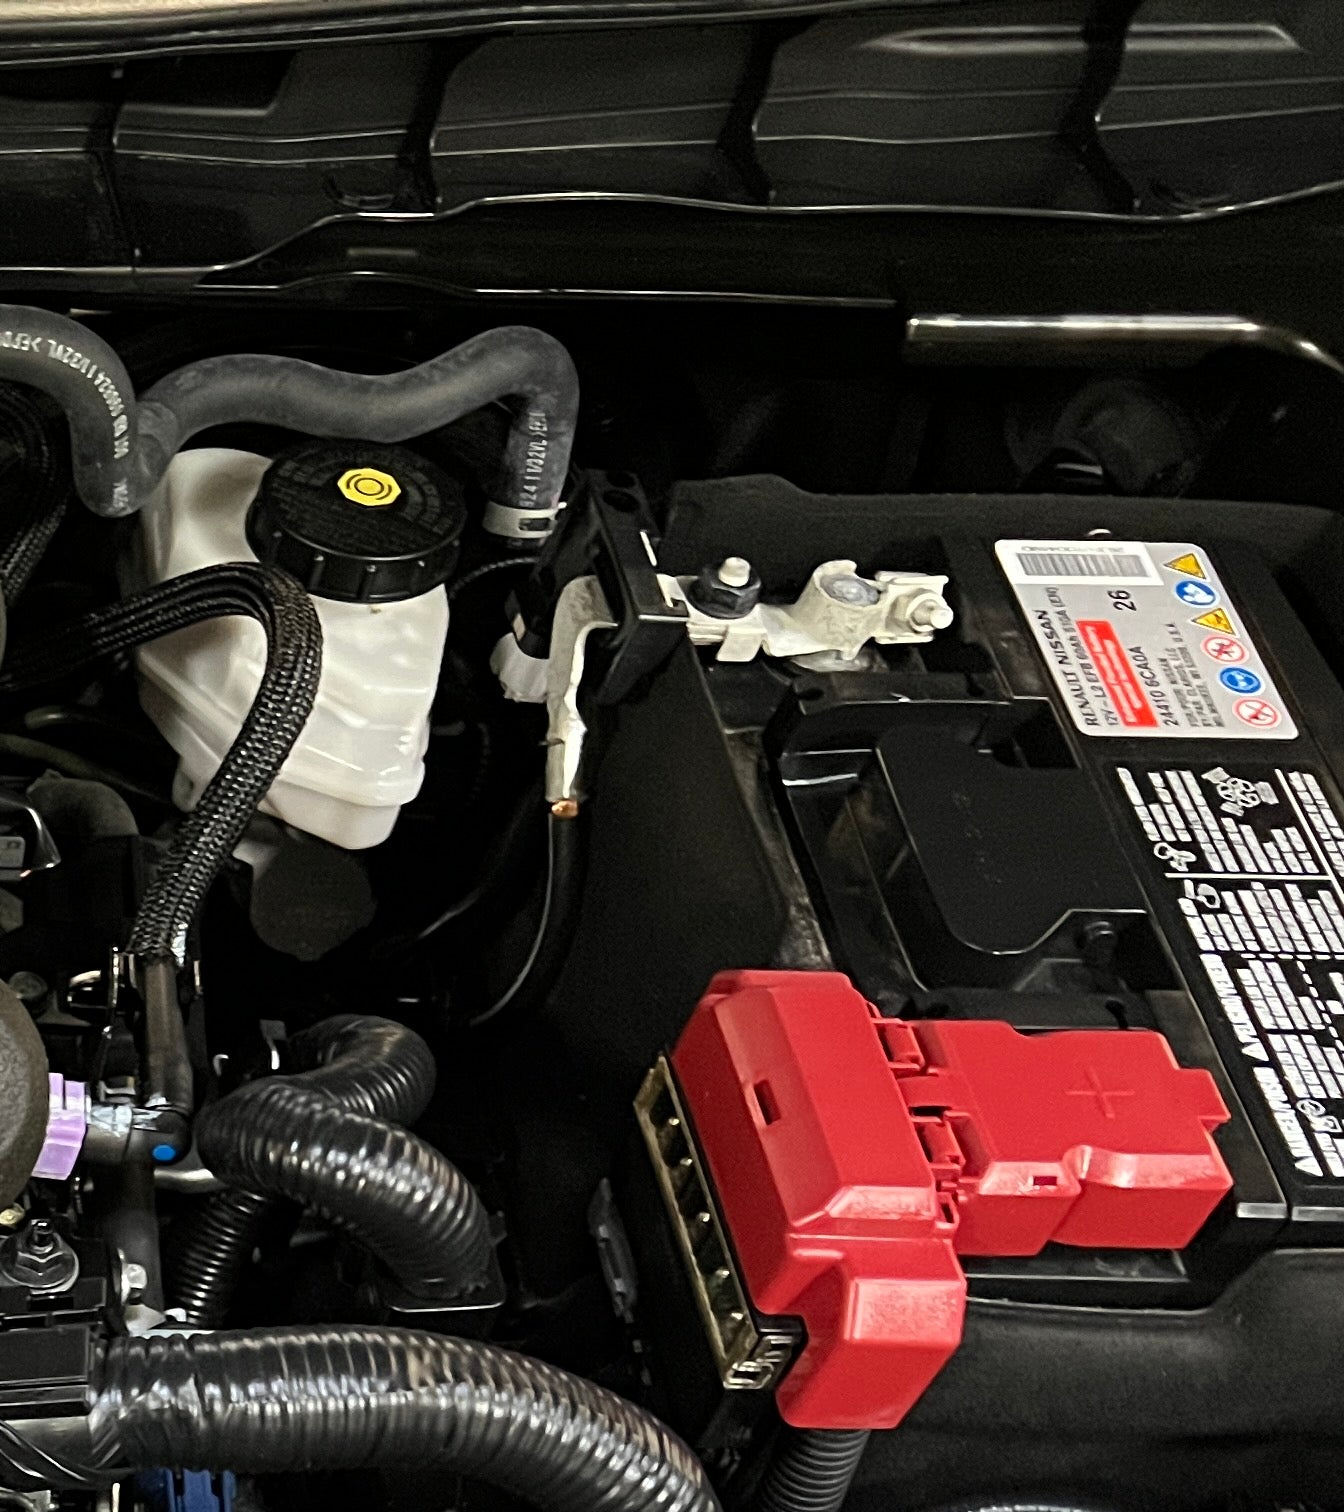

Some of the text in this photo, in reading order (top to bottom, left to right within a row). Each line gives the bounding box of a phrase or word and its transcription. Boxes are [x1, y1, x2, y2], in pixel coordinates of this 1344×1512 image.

[1106, 590, 1137, 611] 26
[1034, 609, 1101, 725] RENAULT NISSAN
[1147, 690, 1179, 725] 24410
